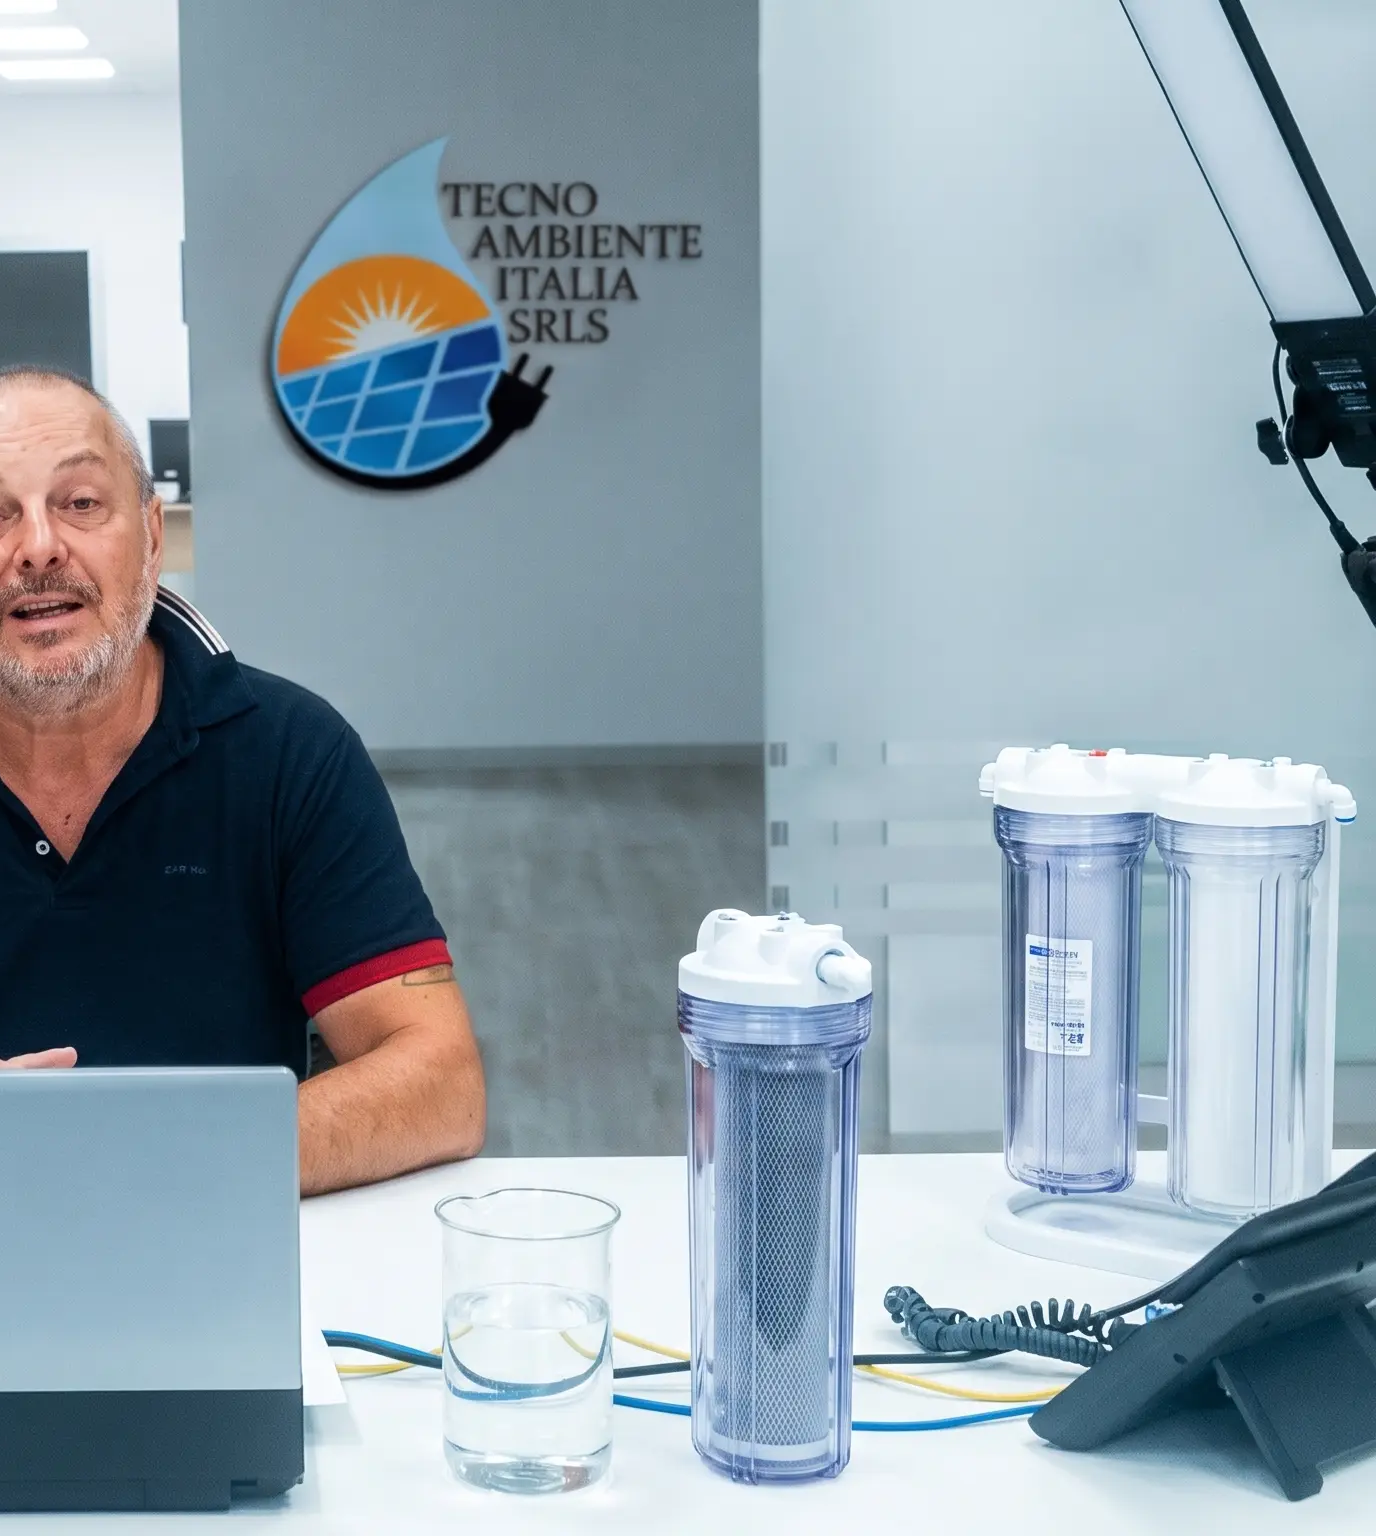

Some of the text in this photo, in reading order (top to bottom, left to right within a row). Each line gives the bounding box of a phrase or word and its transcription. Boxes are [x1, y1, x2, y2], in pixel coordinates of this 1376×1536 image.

[442, 181, 598, 218] TECNO
[470, 223, 703, 259] AMBIENTE
[496, 266, 639, 301] ITALIA
[508, 308, 610, 344] SRLS
